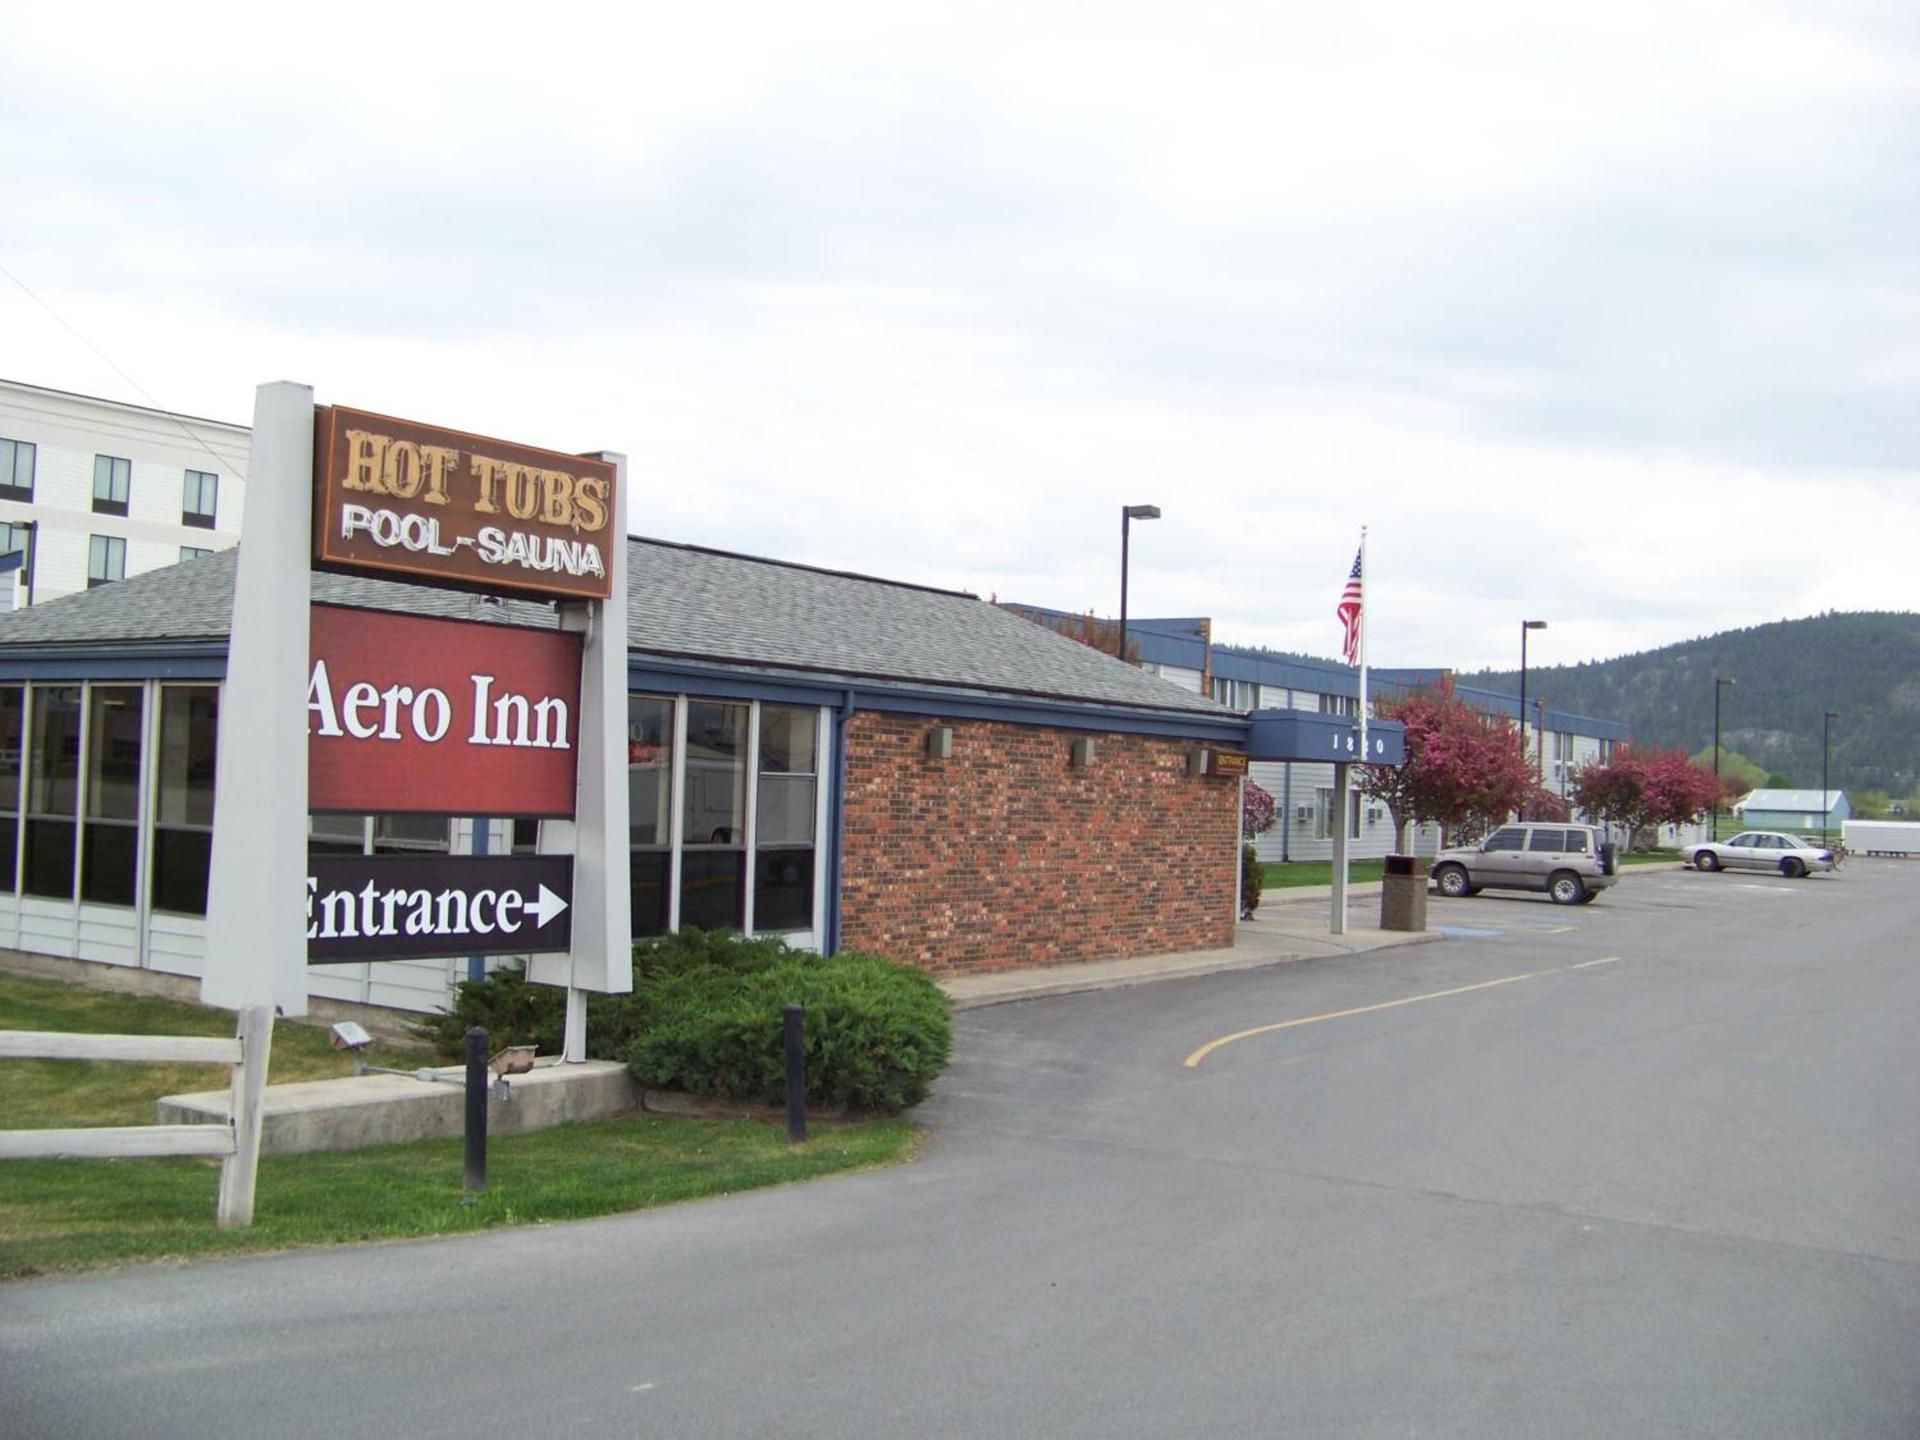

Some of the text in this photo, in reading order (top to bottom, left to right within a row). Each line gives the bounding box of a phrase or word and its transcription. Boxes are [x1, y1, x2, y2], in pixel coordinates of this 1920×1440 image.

[342, 429, 610, 535] HOT TUBS
[308, 660, 571, 749] Aero Inn
